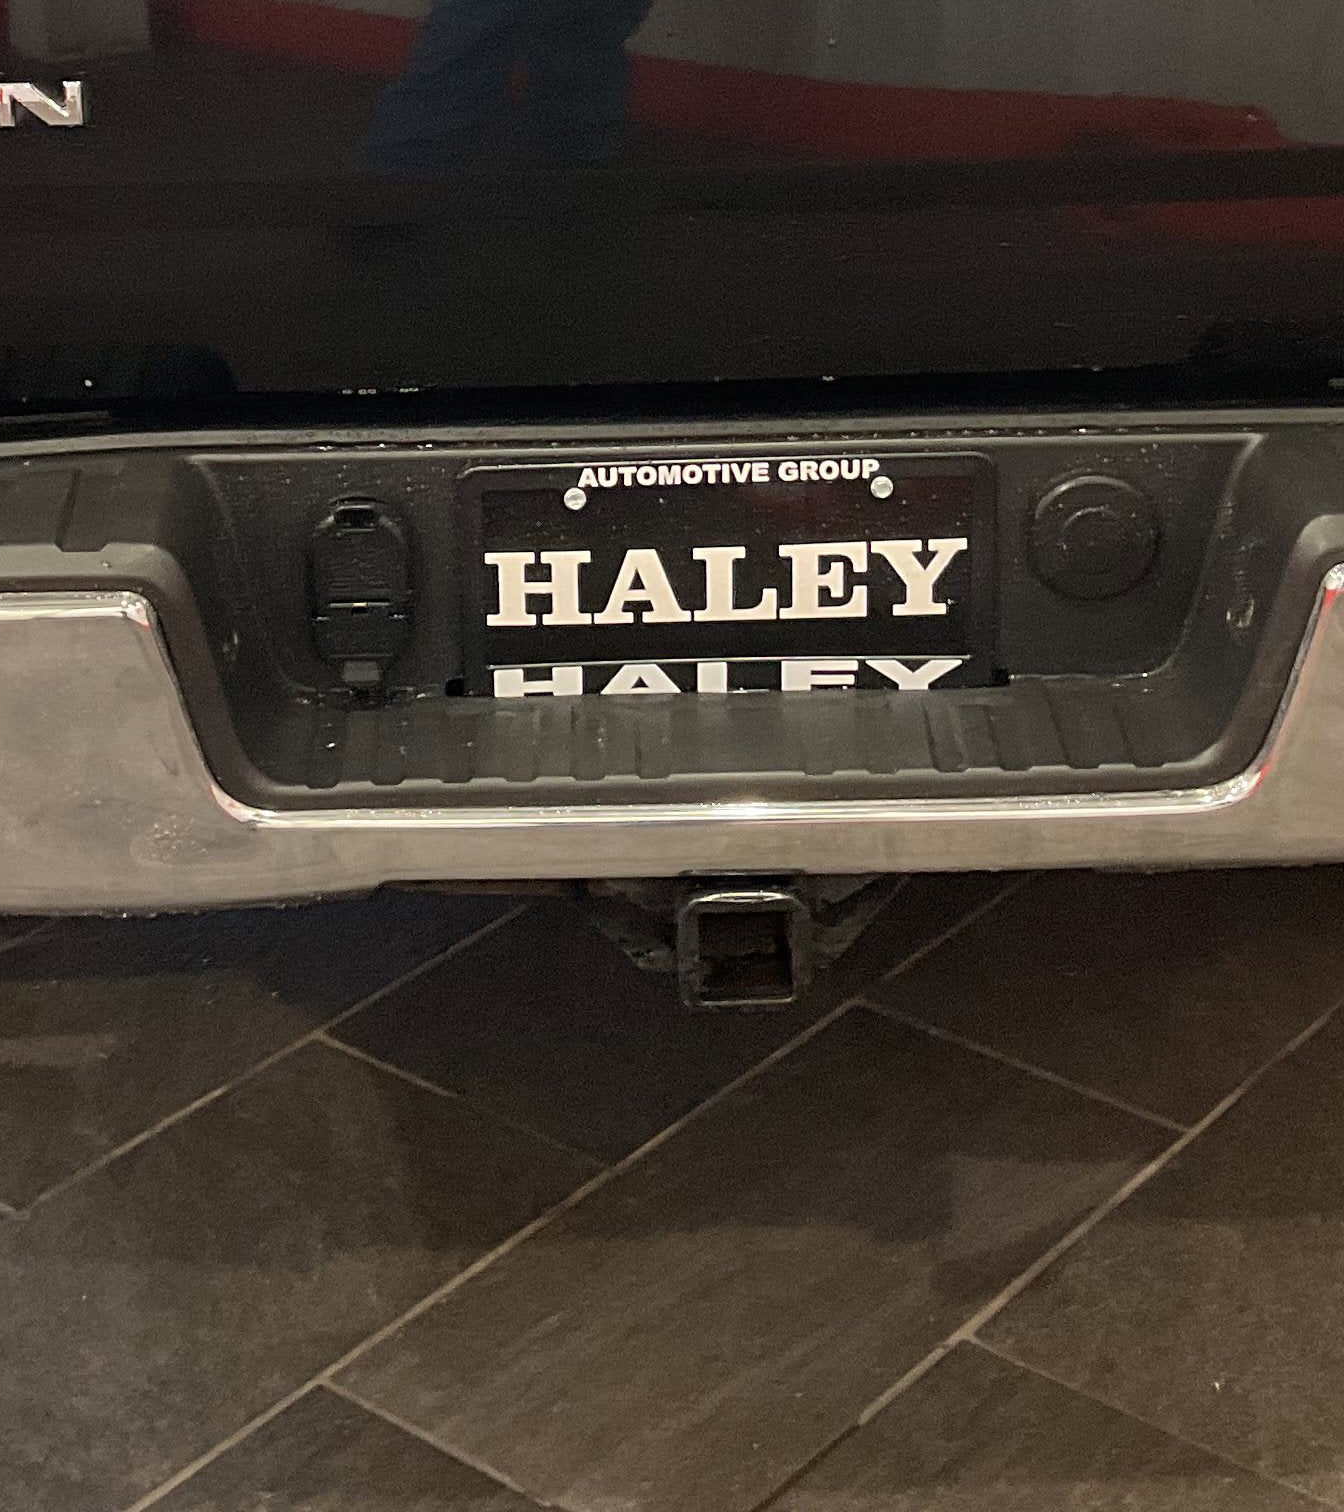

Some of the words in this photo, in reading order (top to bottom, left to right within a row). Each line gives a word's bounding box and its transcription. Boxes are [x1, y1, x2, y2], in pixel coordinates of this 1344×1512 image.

[577, 462, 770, 489] AUTOMOTIVE
[777, 458, 881, 483] GROUP
[484, 537, 968, 627] HALEY
